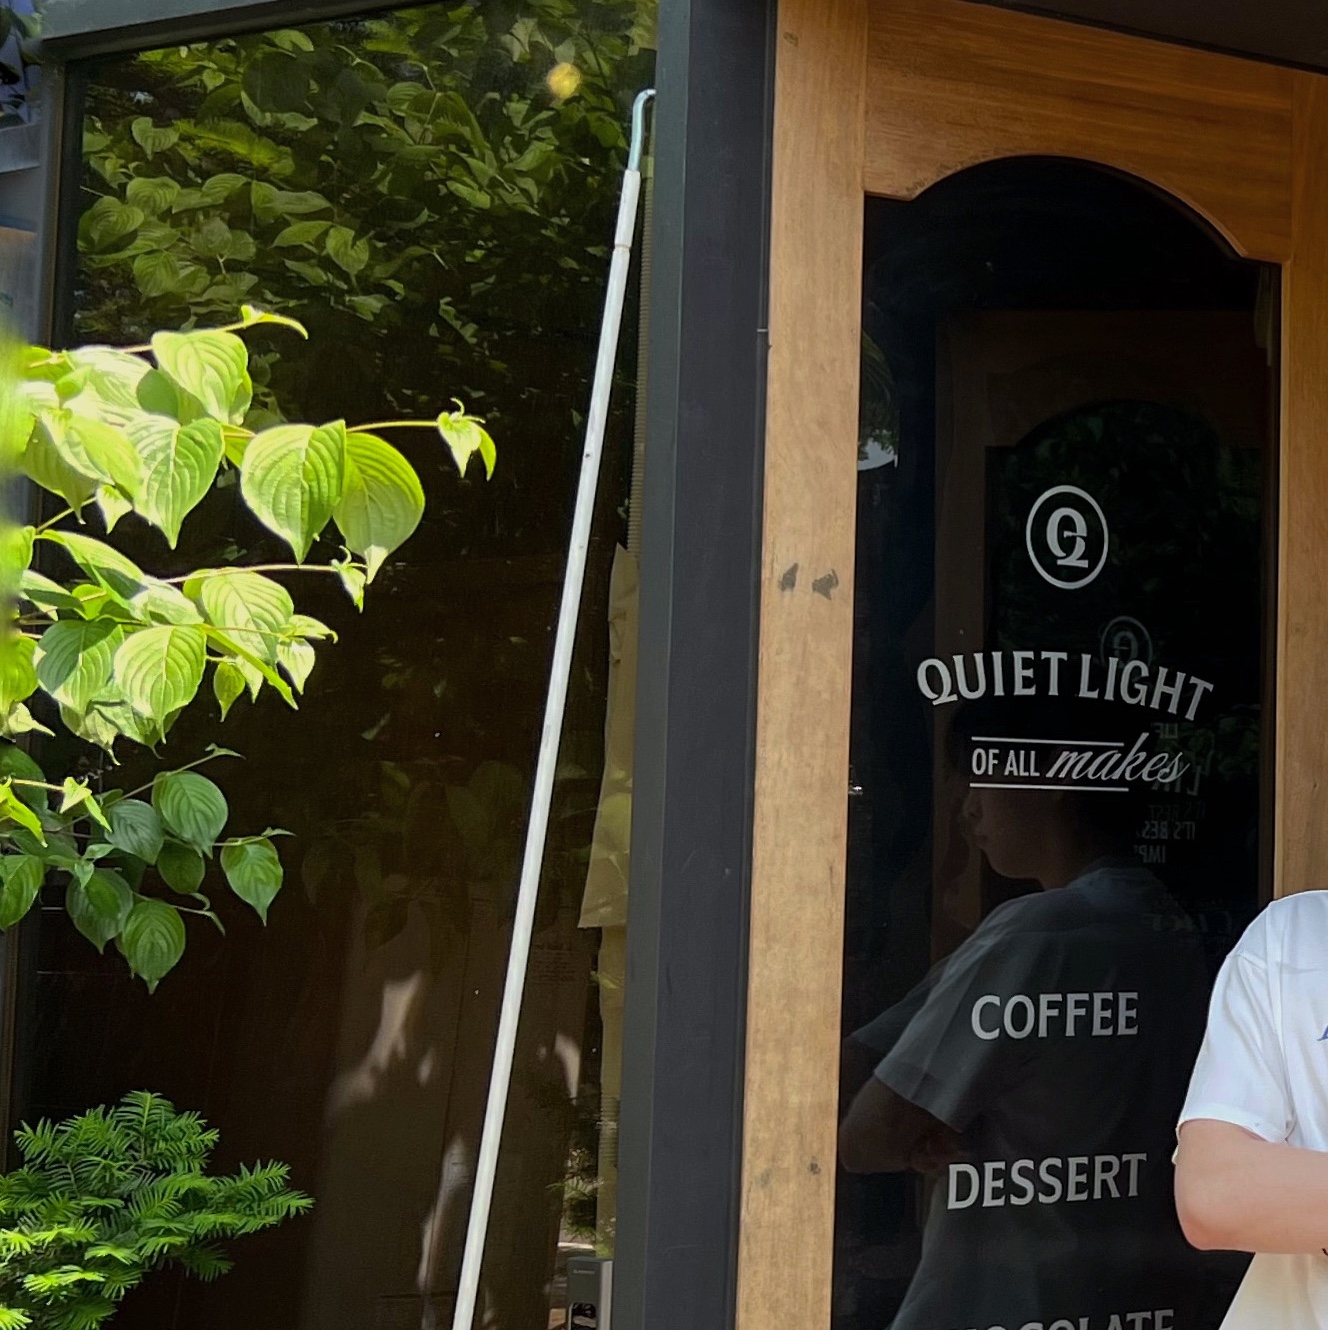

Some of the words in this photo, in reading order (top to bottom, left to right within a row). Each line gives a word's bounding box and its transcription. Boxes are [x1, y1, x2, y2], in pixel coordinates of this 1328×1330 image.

[917, 650, 1068, 706] QUIET
[1078, 652, 1215, 722] LIGHT
[971, 747, 999, 776] OF
[1004, 749, 1040, 777] ALL
[1045, 731, 1191, 784] makes
[971, 992, 1140, 1040] COFFEE
[946, 1153, 1147, 1210] DESSERT
